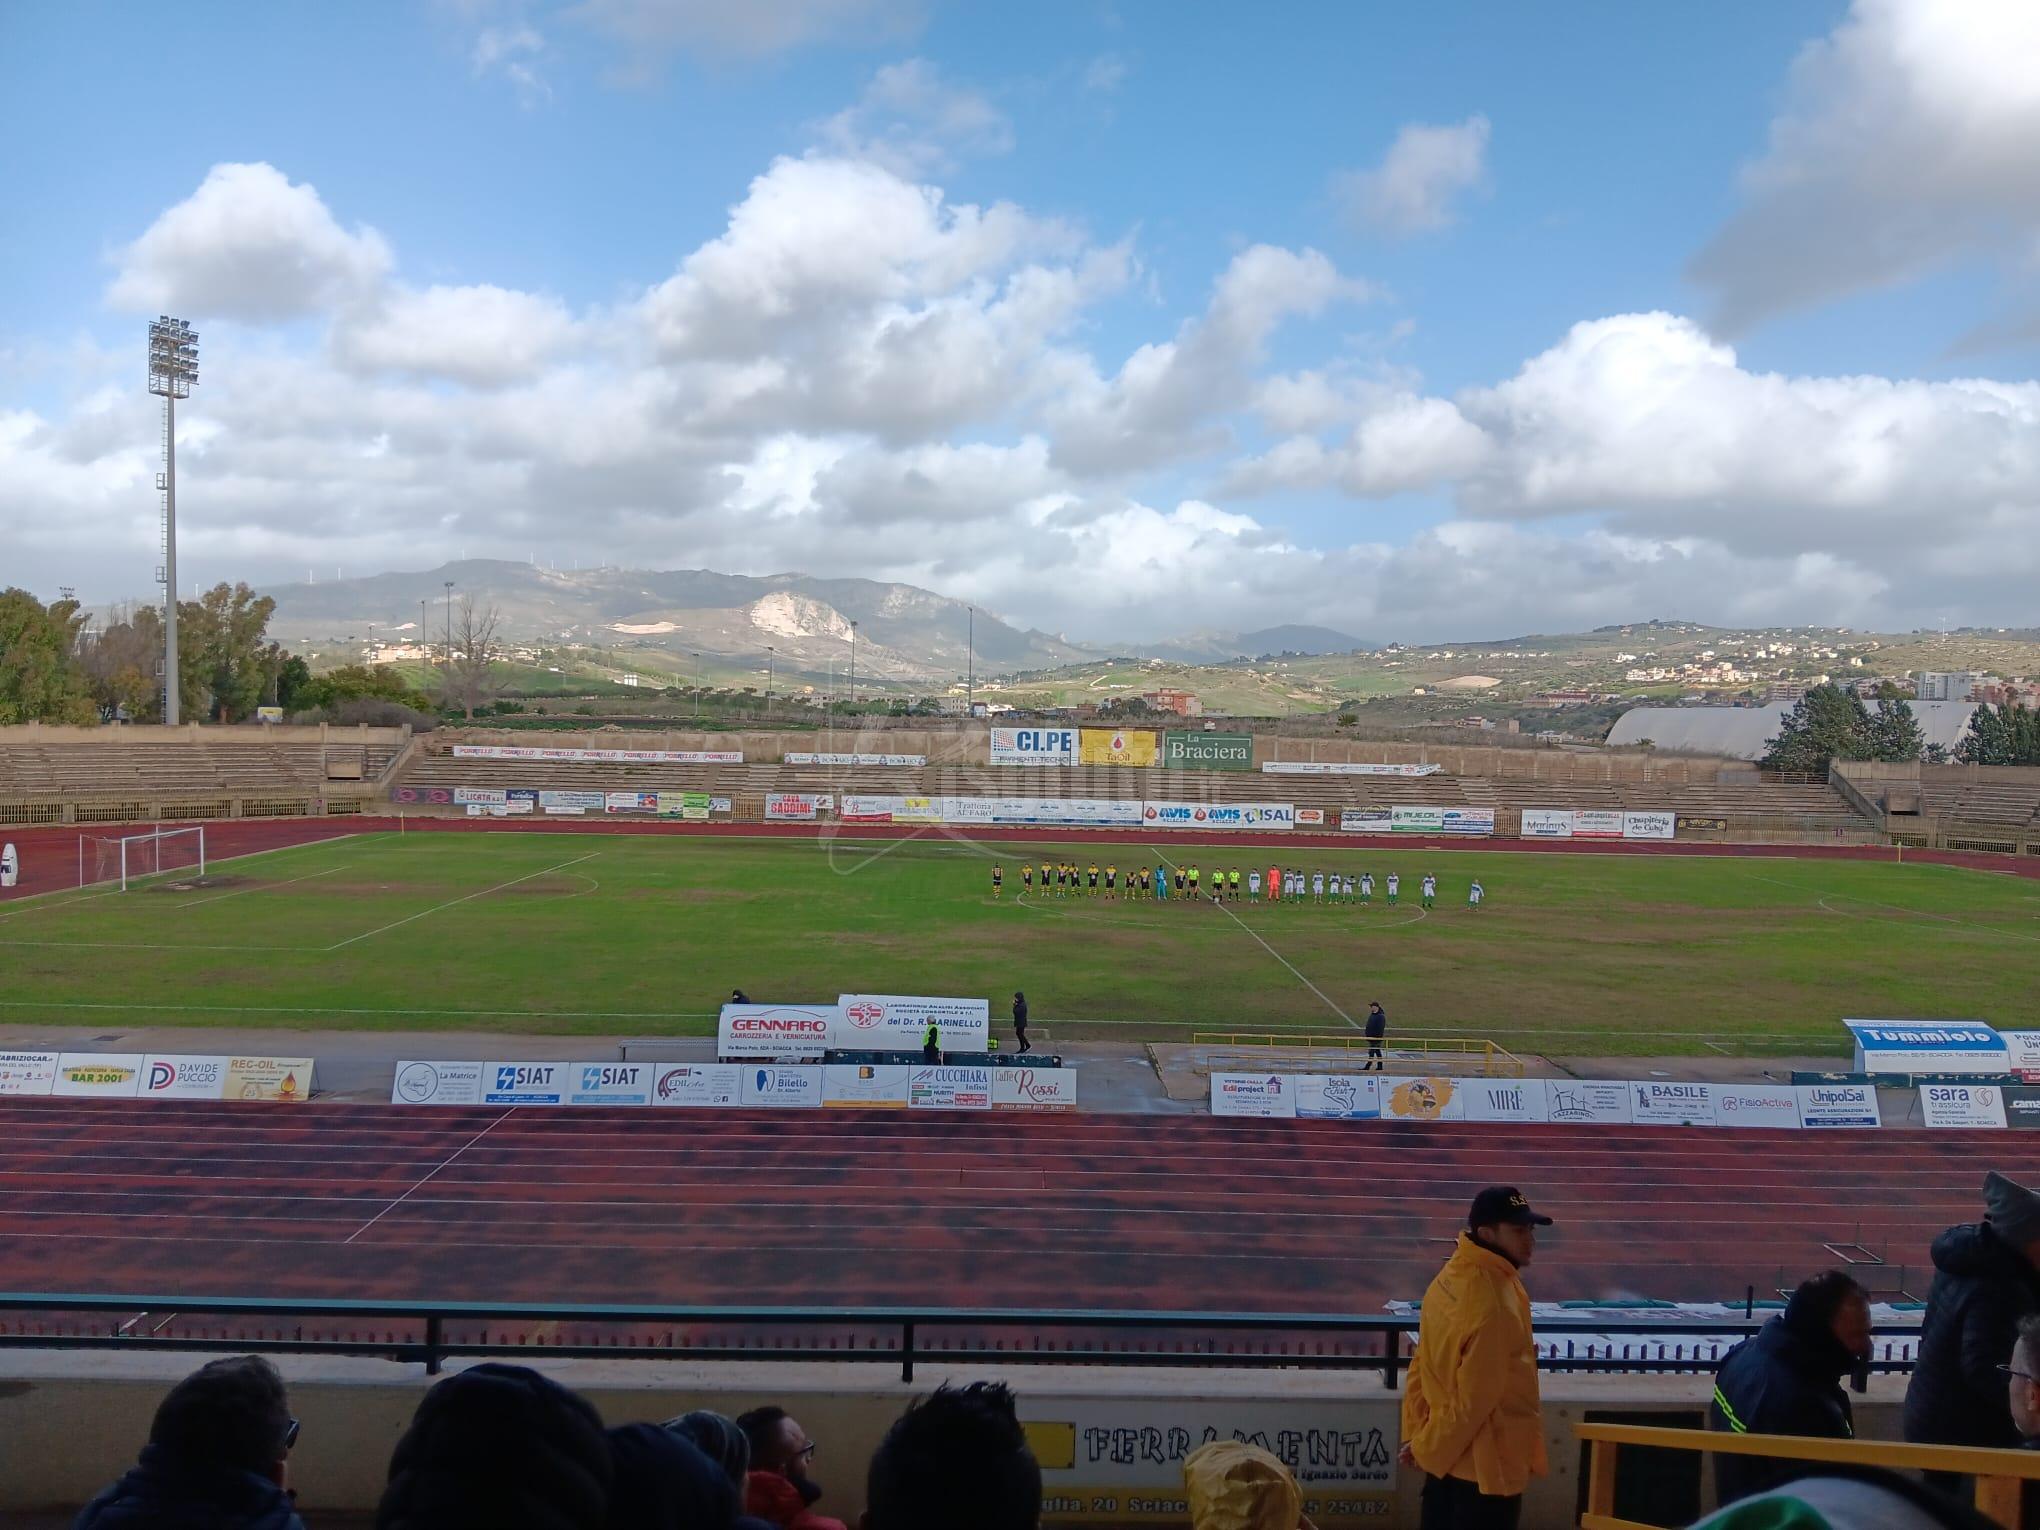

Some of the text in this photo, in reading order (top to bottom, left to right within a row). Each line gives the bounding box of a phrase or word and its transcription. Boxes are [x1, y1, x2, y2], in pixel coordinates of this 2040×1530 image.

[1016, 731, 1071, 752] CI.PE
[1187, 734, 1199, 743] La
[1171, 742, 1248, 760] Braciera
[1158, 807, 1191, 819] AVIS
[1208, 808, 1241, 819] AVIS
[731, 1019, 827, 1032] GENNARO
[887, 1017, 982, 1028] del Dr. R. ARINELLO
[782, 1033, 826, 1041] VERNICIATURA
[180, 1063, 218, 1073] DAVIDE
[231, 1059, 276, 1069] REC-OIL
[71, 1073, 122, 1083] BAR 2001
[177, 1073, 216, 1083] PUCCIO
[439, 1071, 477, 1079] La Matrice
[516, 1067, 554, 1084] SIAT
[601, 1067, 639, 1085] SIAT
[935, 1068, 988, 1083] CUCCHIARA
[778, 1078, 808, 1087] Bilello
[965, 1083, 988, 1091] Infissi
[1014, 1069, 1060, 1103] Rossi
[1328, 1077, 1350, 1087] Isola
[1651, 1085, 1709, 1098] BASILE
[1811, 1088, 1865, 1105] UnipolSai
[1929, 1088, 1970, 1101] sara
[1931, 1101, 1971, 1109] ti assicura
